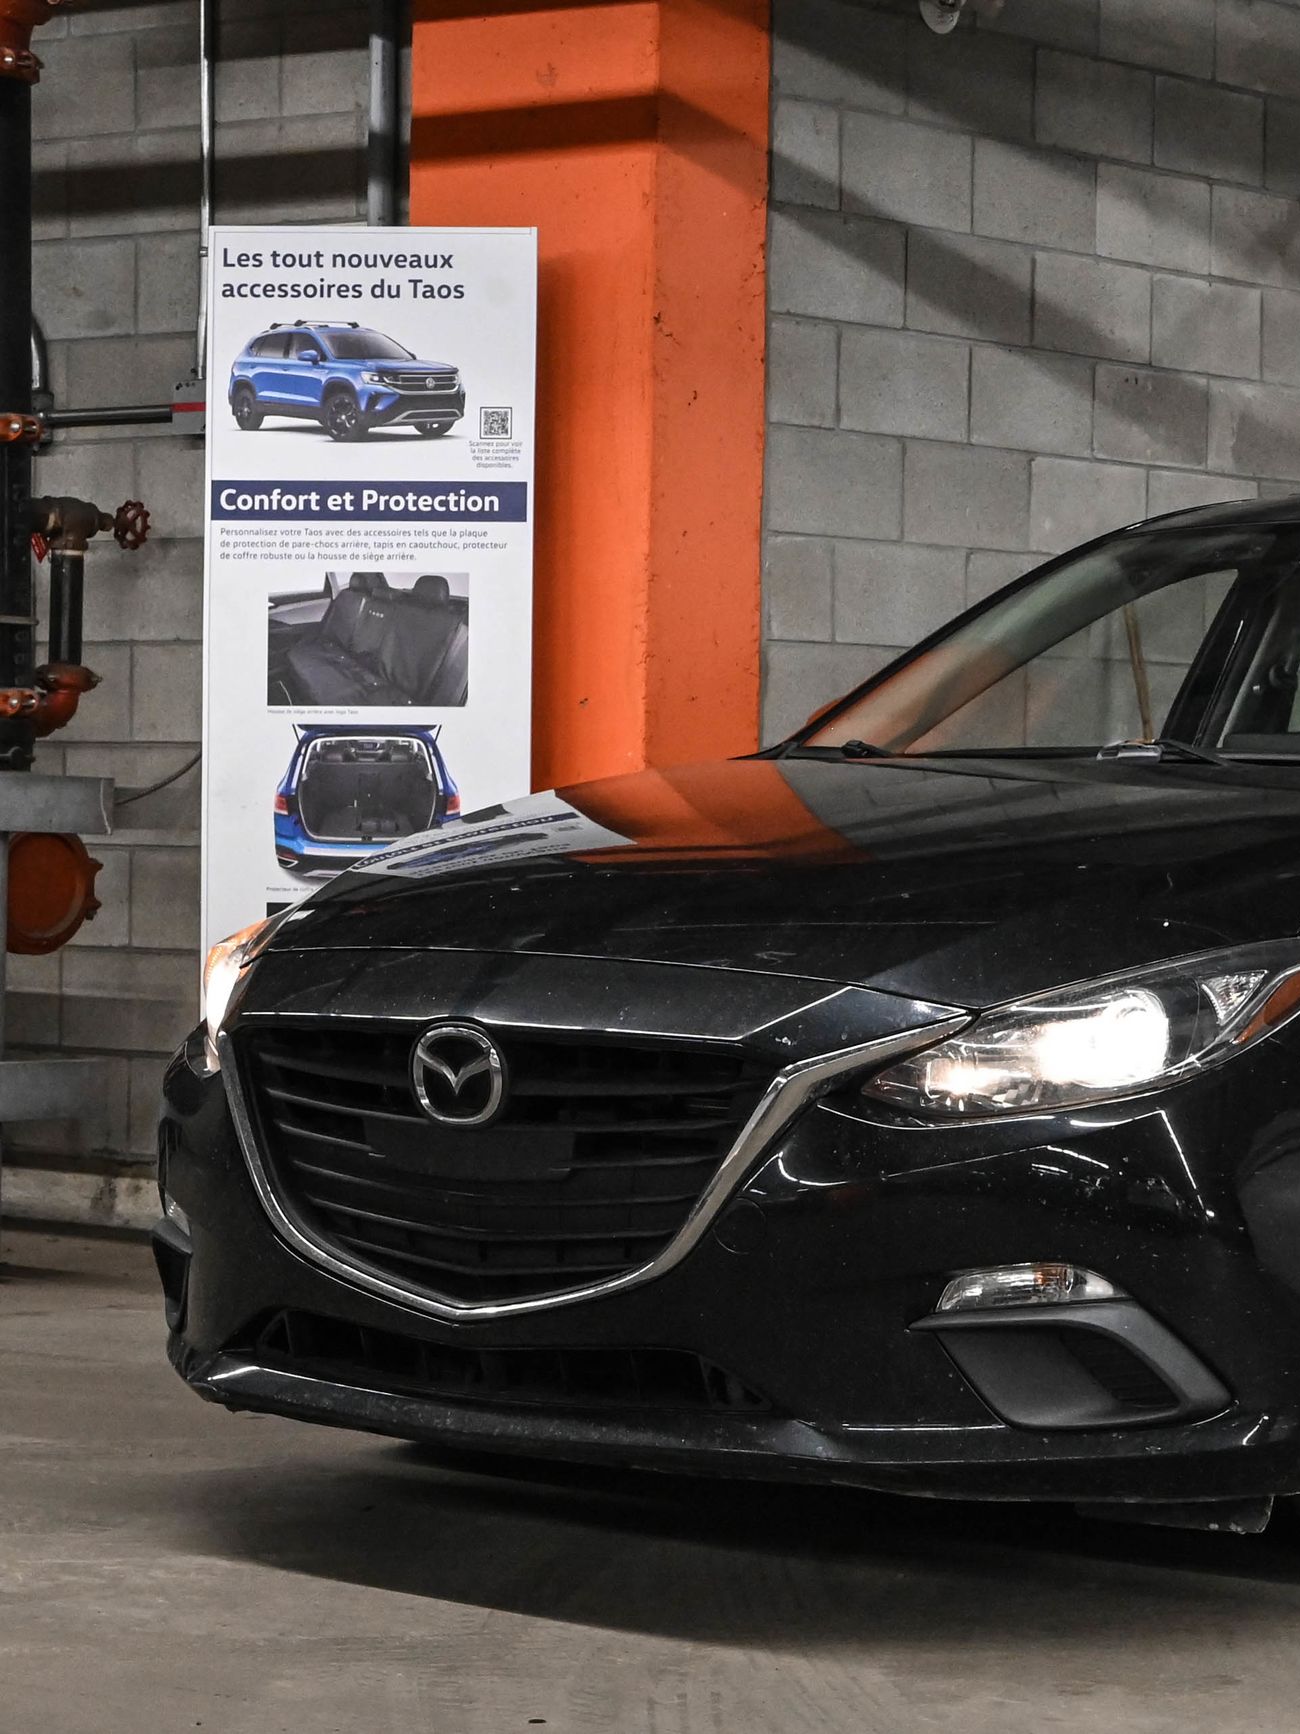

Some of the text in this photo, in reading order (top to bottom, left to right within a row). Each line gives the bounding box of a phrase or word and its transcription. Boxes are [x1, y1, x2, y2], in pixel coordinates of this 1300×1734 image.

[223, 247, 454, 269] Les tout nouveaux
[221, 278, 465, 300] accessoires du Taos
[219, 488, 500, 513] Confort et Protection
[220, 527, 488, 539] Personnalisez votre Taos avec des accessoires tels que la plaque
[220, 540, 508, 551] de protection de pare-chocs arrière, tapis en caoutchouc, protecteur
[220, 551, 231, 560] de
[233, 551, 258, 560] coffre
[260, 551, 293, 560] robuste
[308, 551, 316, 560] la
[317, 551, 347, 560] housse
[349, 551, 361, 560] de
[362, 551, 385, 563] siège
[386, 551, 417, 561] arrière.
